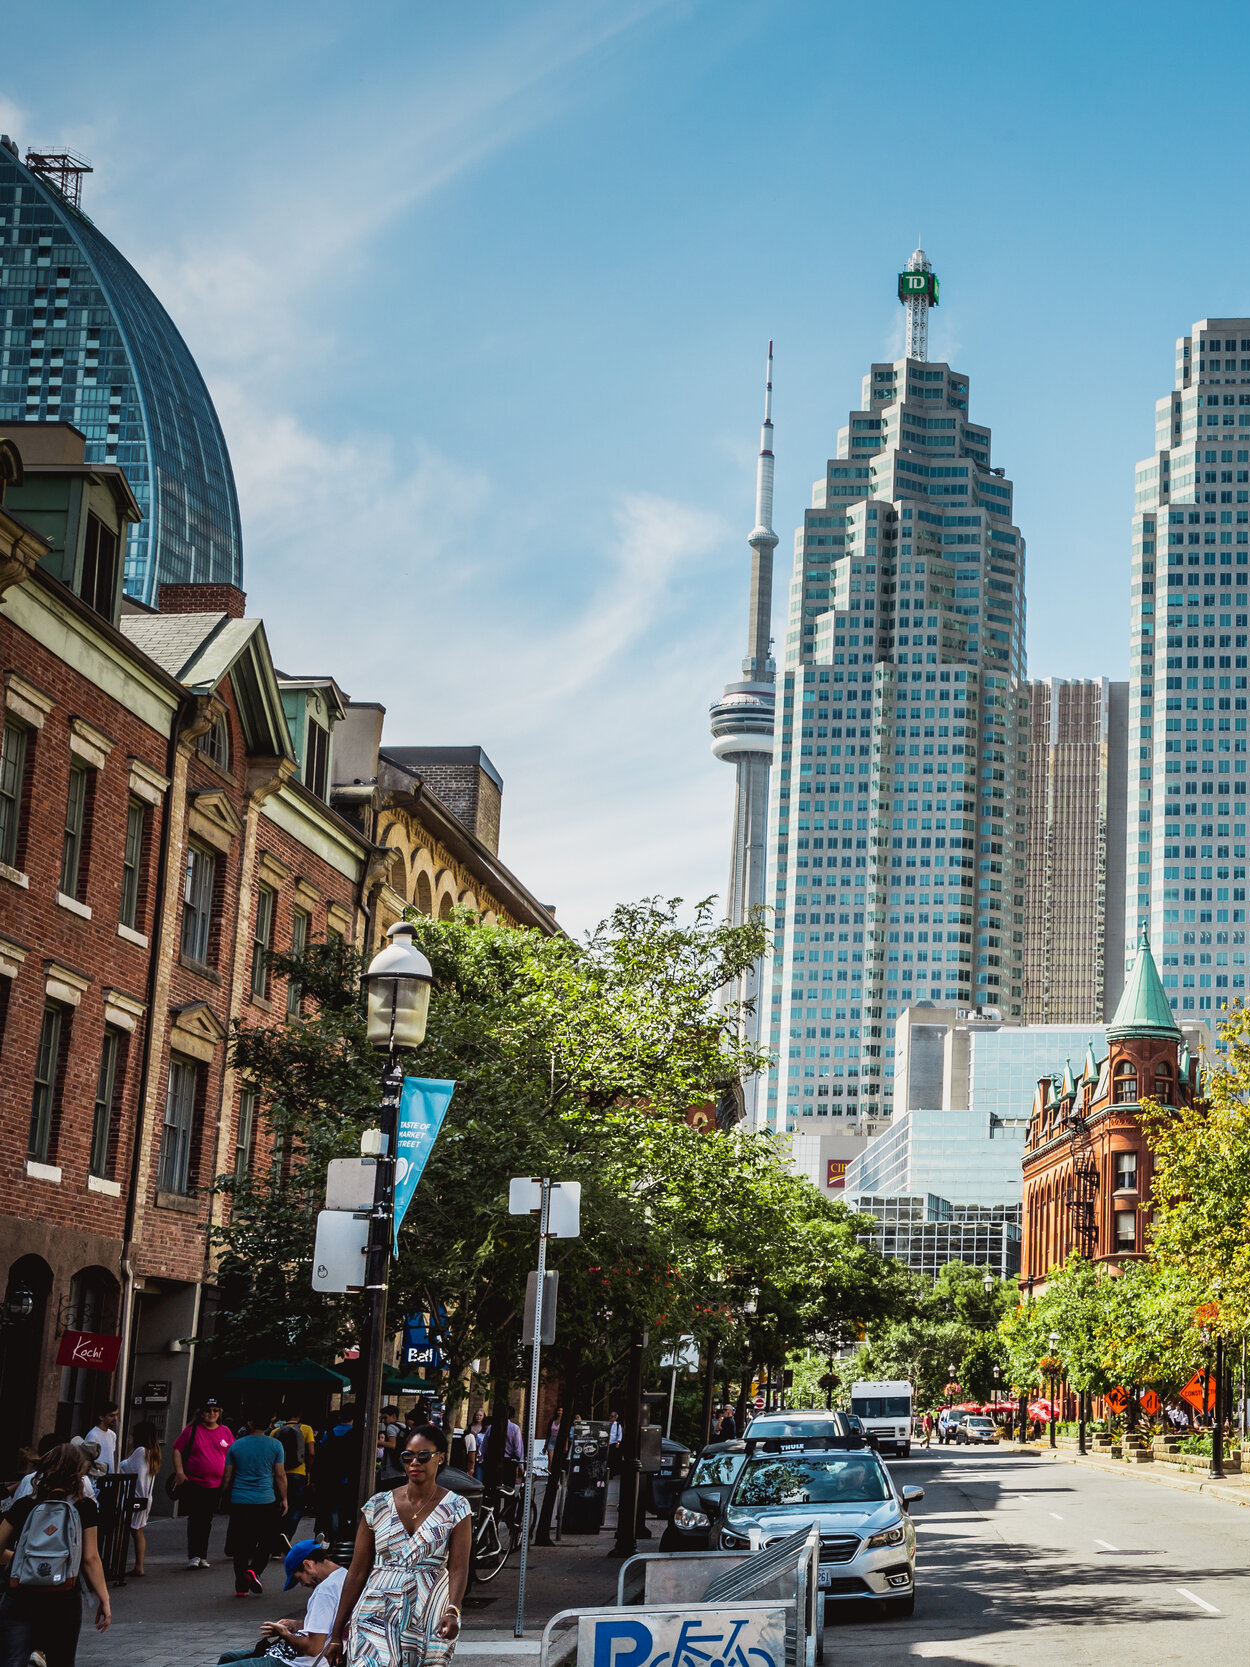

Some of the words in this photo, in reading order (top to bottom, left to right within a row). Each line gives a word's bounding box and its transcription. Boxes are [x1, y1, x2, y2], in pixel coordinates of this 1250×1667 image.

[906, 276, 925, 289] TD
[72, 1336, 104, 1362] Kochi
[780, 1443, 804, 1451] THULE
